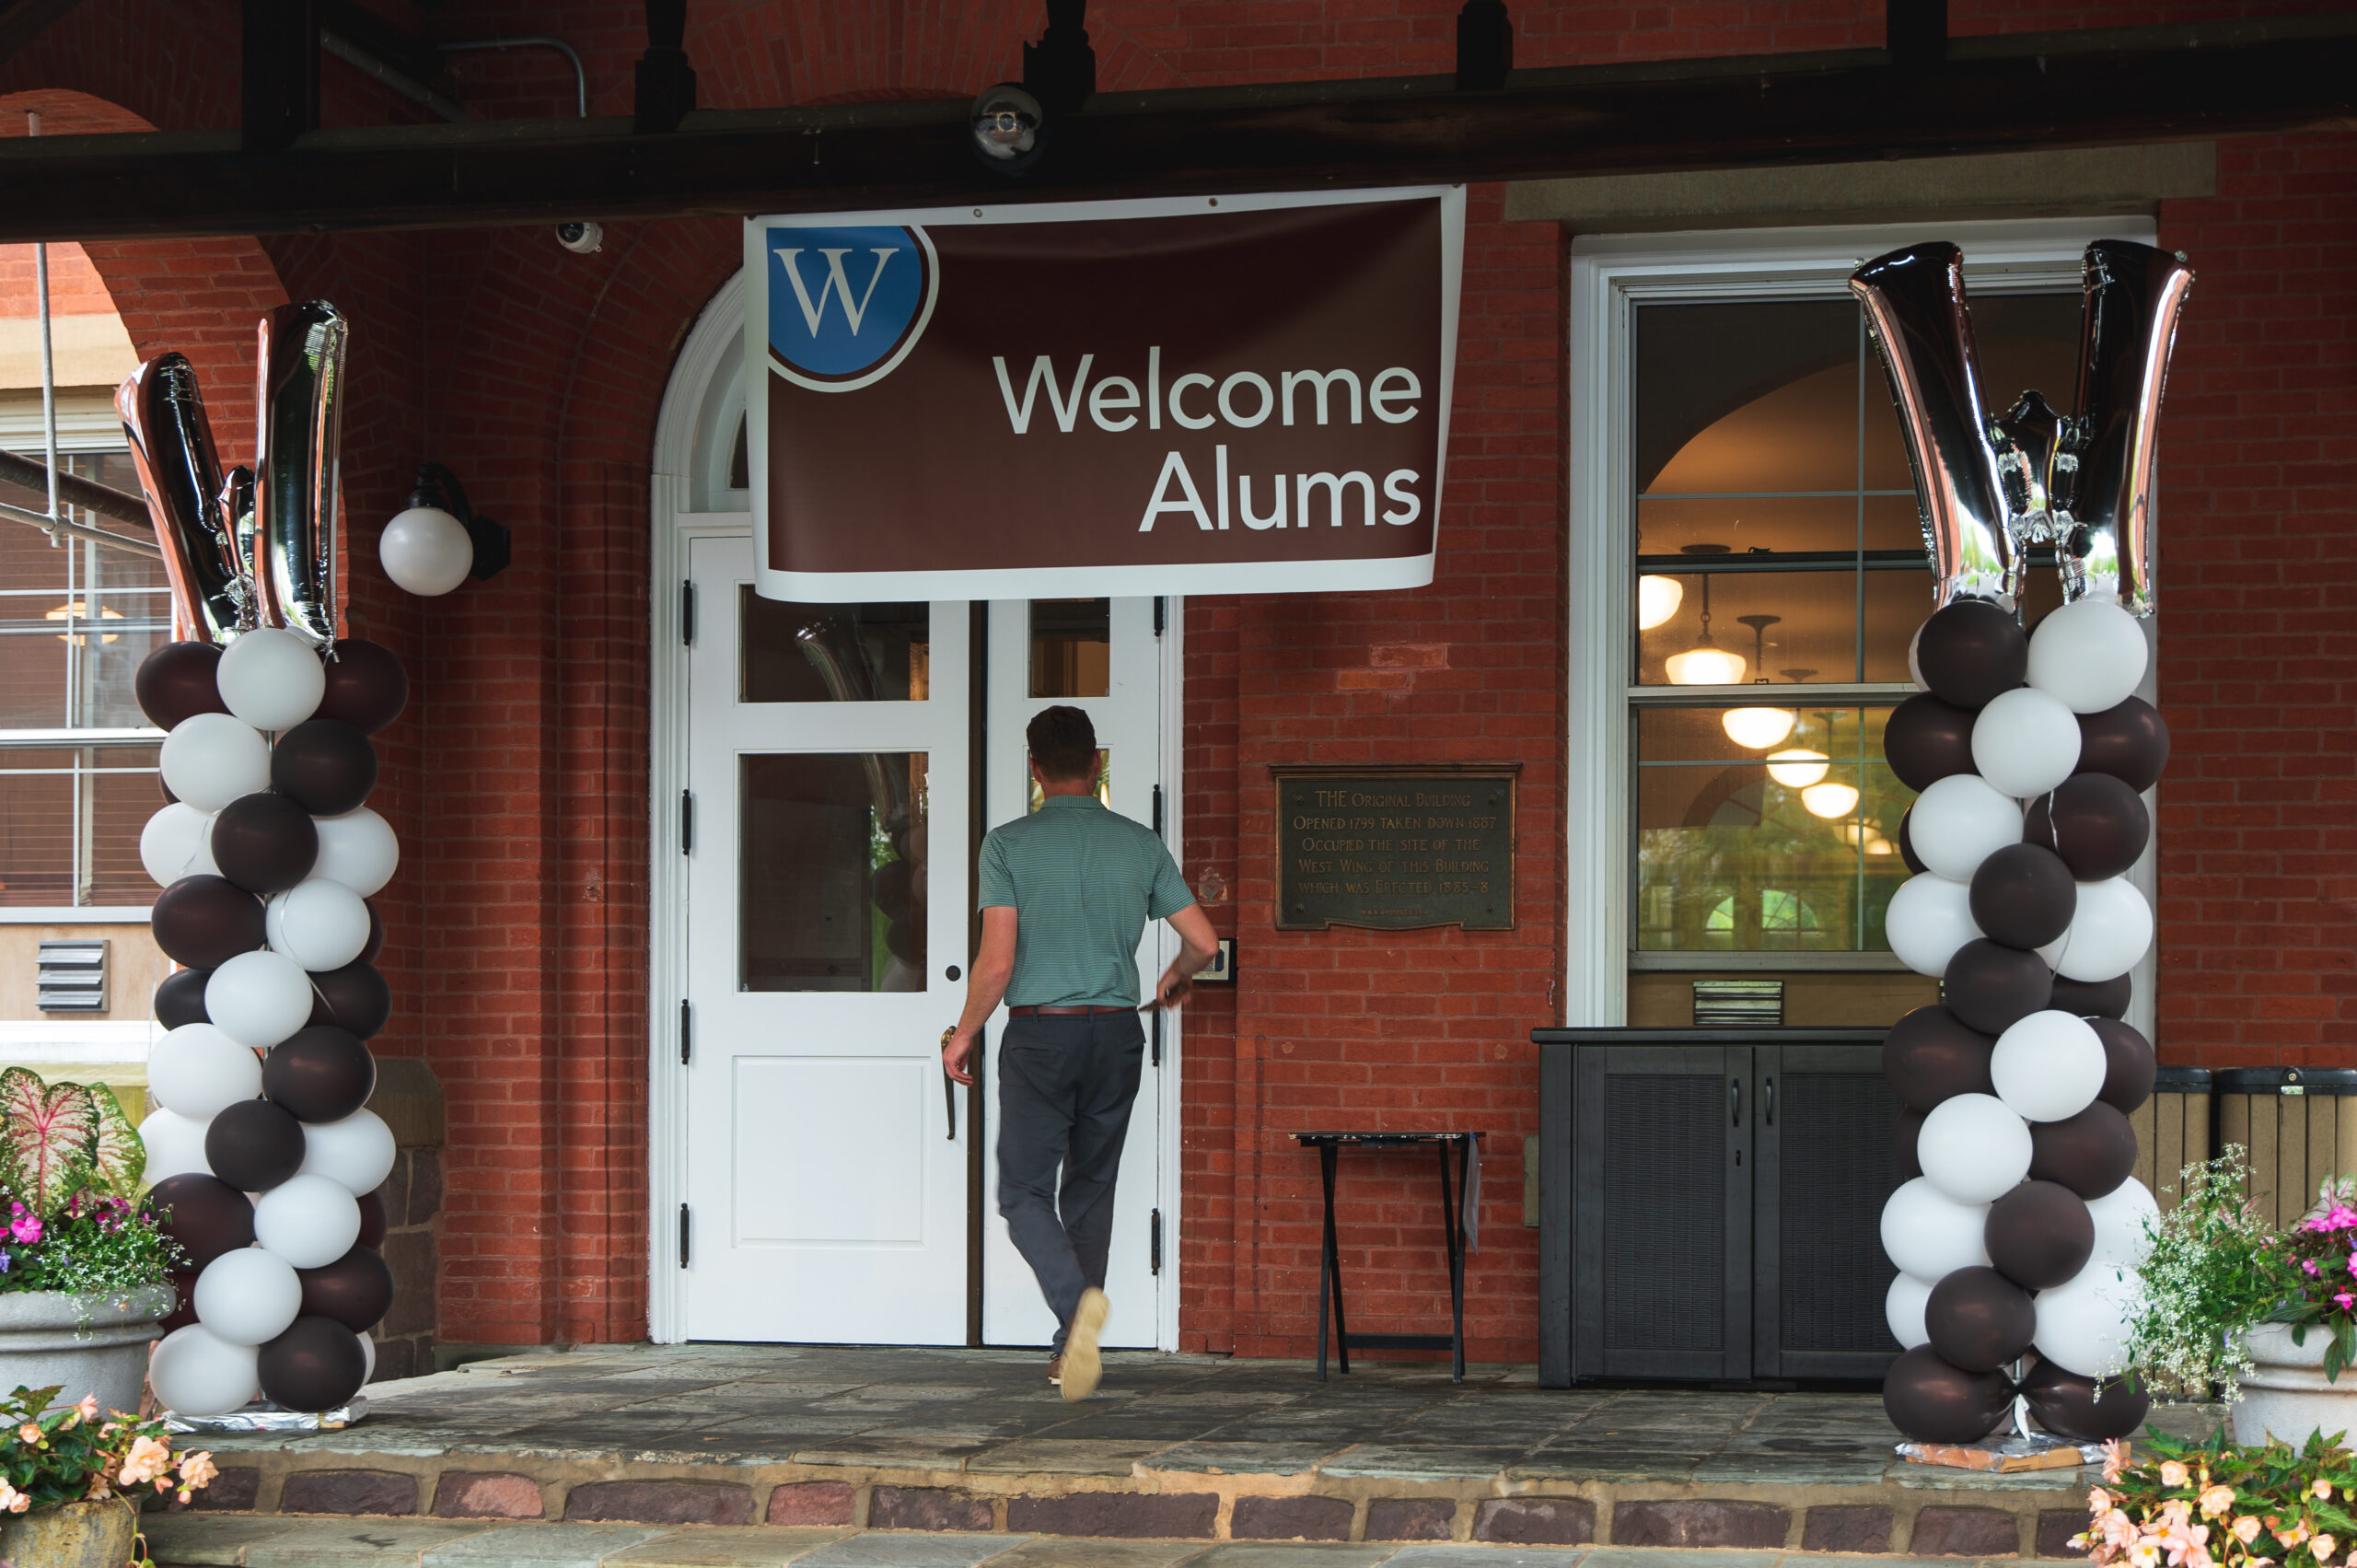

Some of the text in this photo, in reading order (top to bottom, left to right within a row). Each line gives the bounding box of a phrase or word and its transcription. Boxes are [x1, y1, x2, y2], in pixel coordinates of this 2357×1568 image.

[772, 247, 900, 339] W
[993, 345, 1422, 435] Welcome
[1138, 444, 1422, 533] Alums
[1314, 790, 1471, 807] THE ORIGINAL BUILDING
[1293, 815, 1496, 830] OPENED 1799 TAKEN DOWN 1887
[1302, 837, 1481, 853] OCCUPIED THE SITE OF THE
[1297, 858, 1489, 875] WEST WING OF THIS BUILDING
[1297, 882, 1339, 895] WHICH
[1344, 882, 1370, 895] WAS
[1375, 879, 1432, 895] ERECTED
